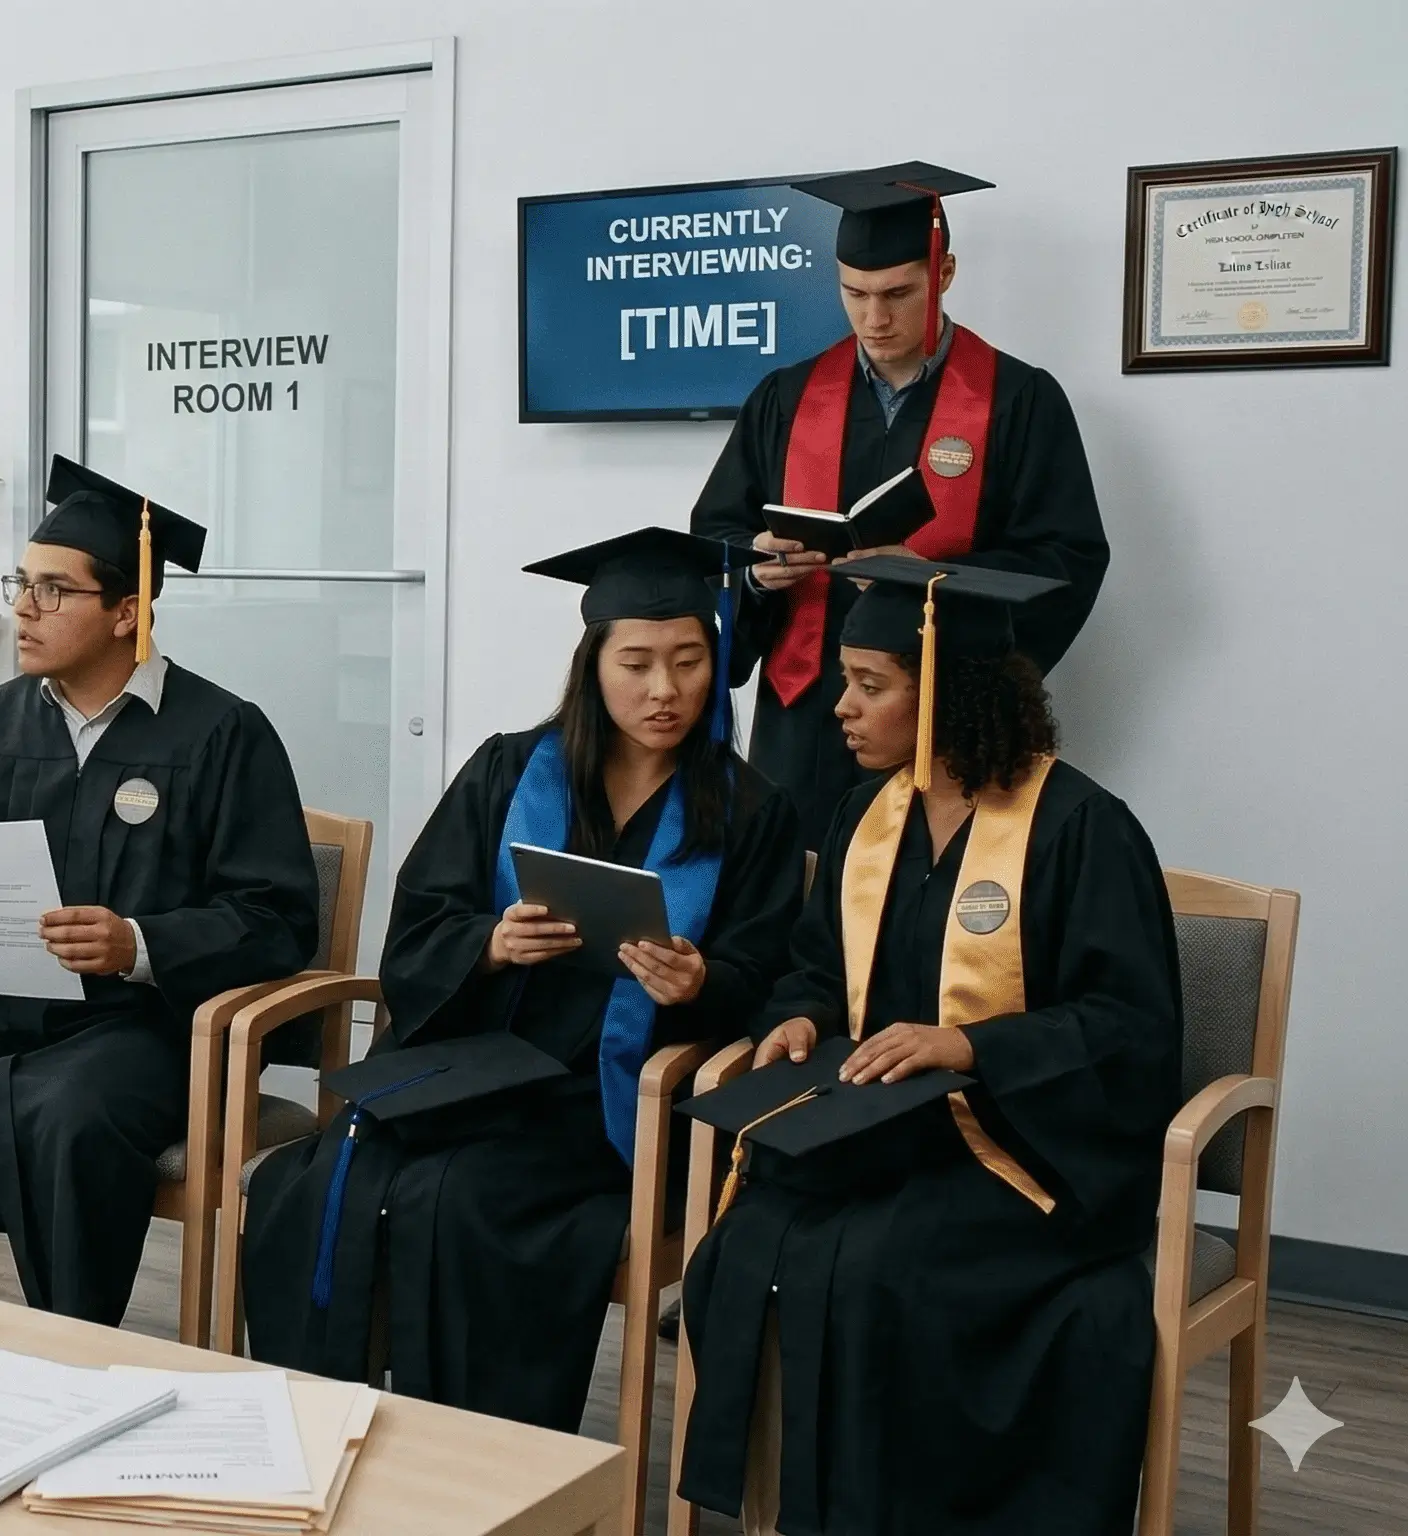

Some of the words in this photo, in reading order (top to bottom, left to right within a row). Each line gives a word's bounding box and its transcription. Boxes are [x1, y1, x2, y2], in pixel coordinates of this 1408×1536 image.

[609, 207, 789, 243] CURRENTLY
[586, 244, 812, 281] INTERVIEWING:
[620, 301, 776, 361] [TIME]
[147, 334, 329, 371] INTERVIEW
[173, 382, 272, 414] ROOM
[286, 380, 298, 411] 1
